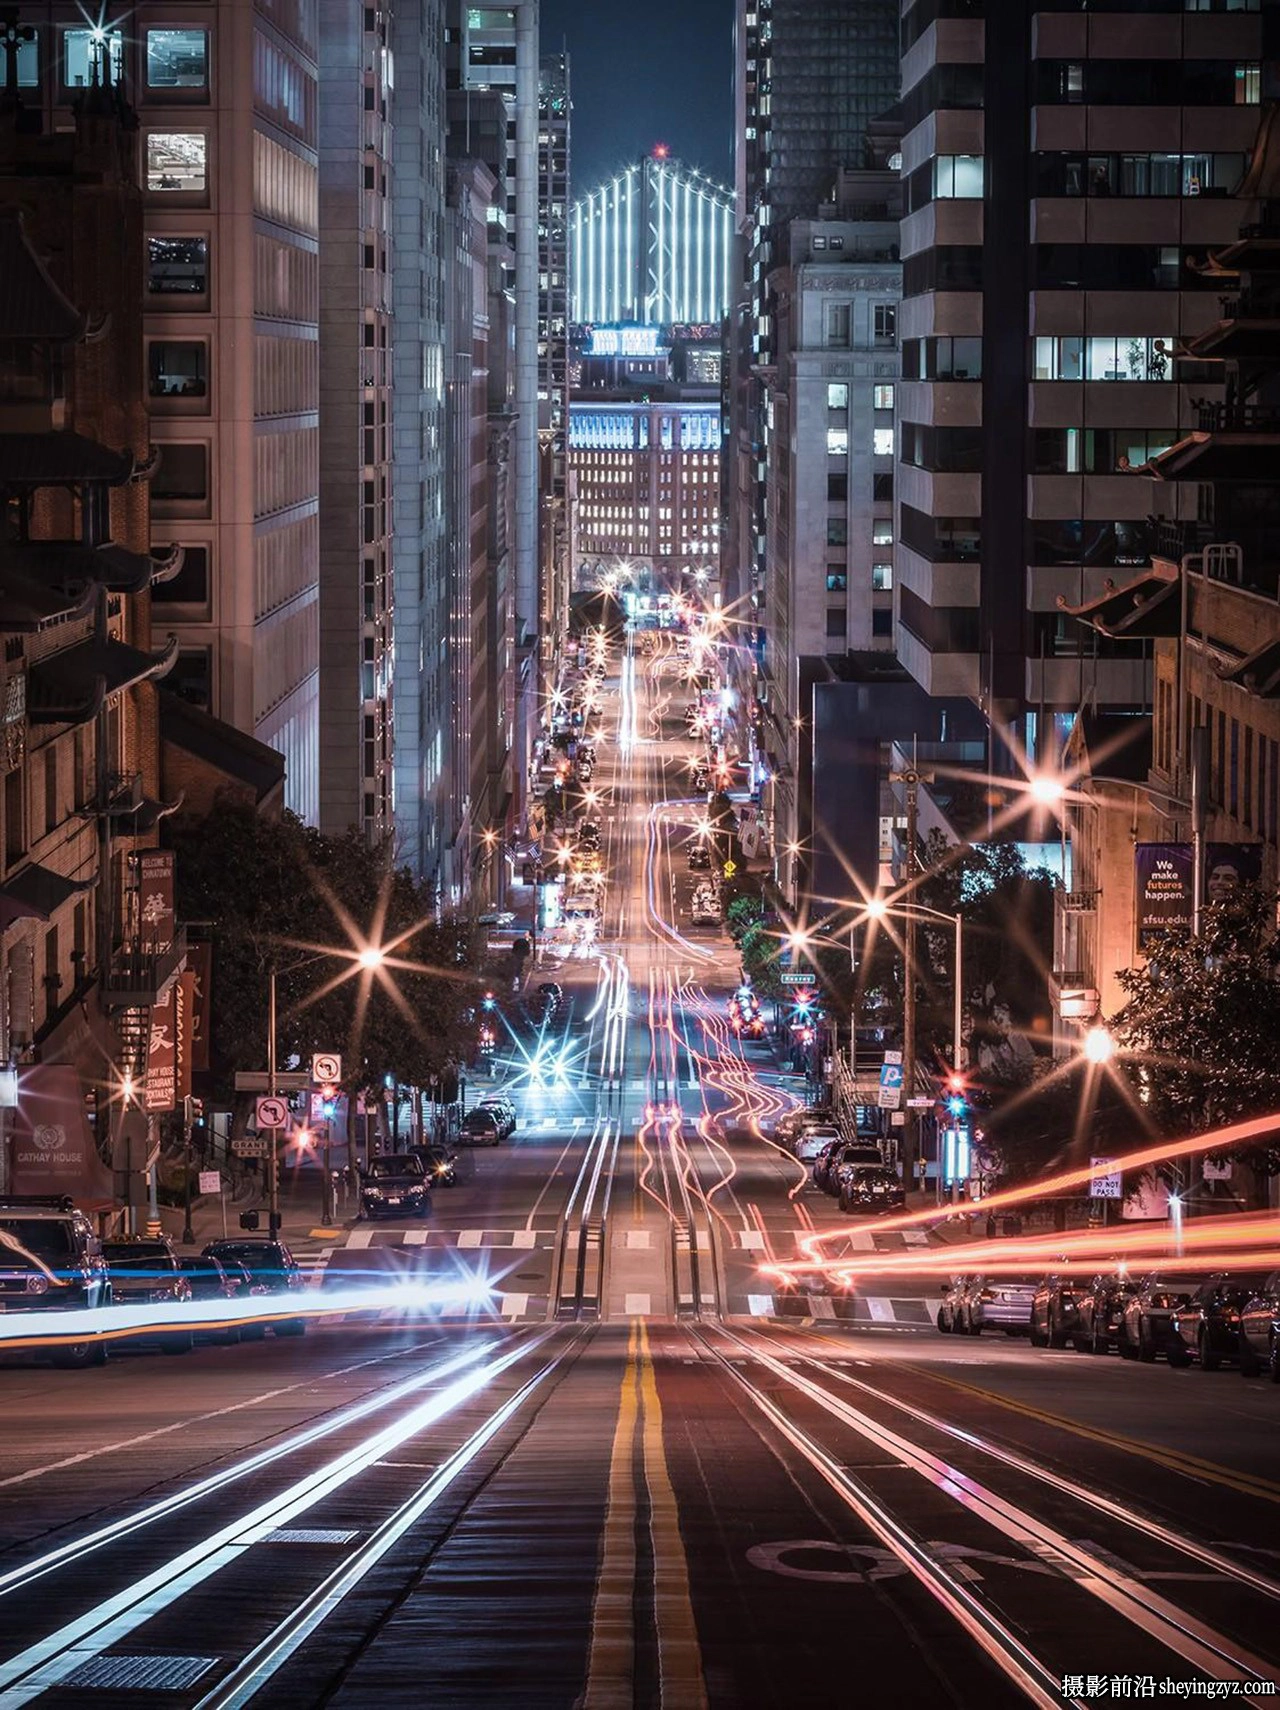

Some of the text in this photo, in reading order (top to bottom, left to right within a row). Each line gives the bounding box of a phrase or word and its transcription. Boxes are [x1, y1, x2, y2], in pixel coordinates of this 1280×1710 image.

[141, 857, 165, 868] WELCOME
[1156, 860, 1174, 870] We
[142, 868, 172, 879] CHINATOWN
[1151, 870, 1179, 879] make
[1147, 880, 1183, 890] futures
[1144, 890, 1185, 901] happen.
[1142, 914, 1188, 925] sfsu.edu
[17, 1152, 83, 1163] CATHAY HOUSE
